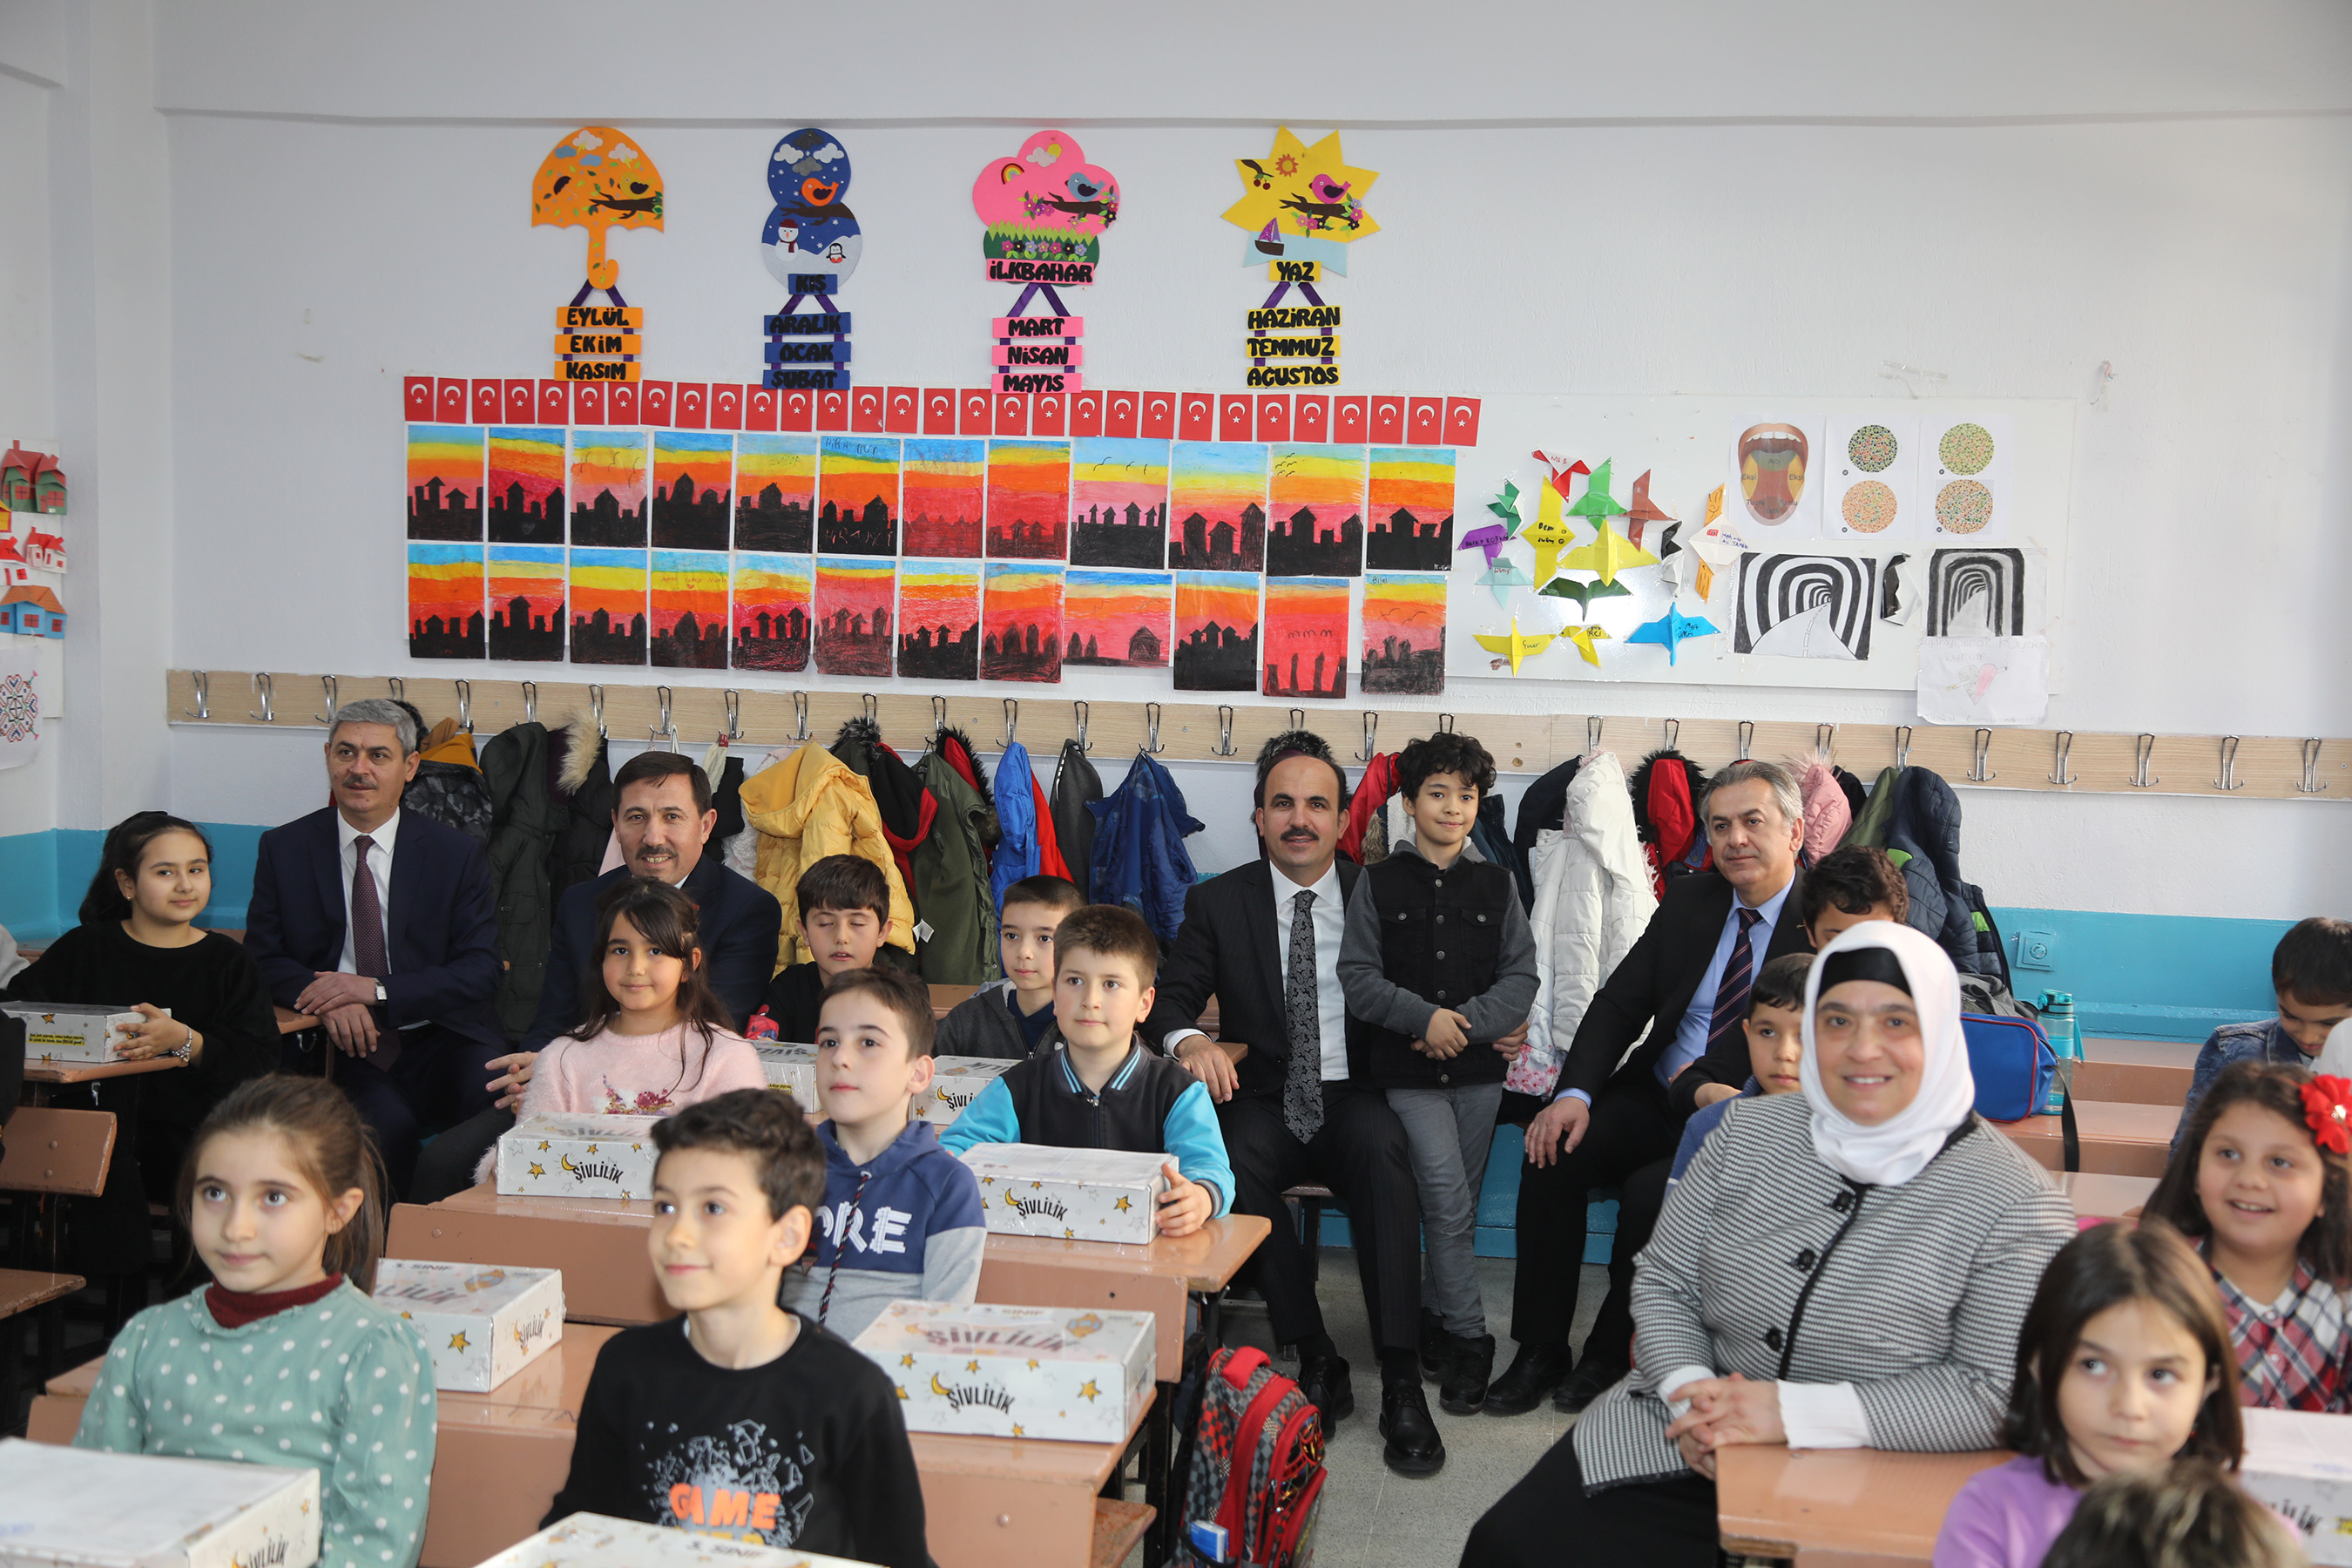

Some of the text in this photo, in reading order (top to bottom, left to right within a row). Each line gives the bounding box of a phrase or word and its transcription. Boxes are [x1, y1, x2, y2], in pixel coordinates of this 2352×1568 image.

[990, 261, 1092, 282] İLKBAHAR
[1277, 261, 1315, 281] YAZ
[795, 275, 827, 294] KIŞ
[567, 308, 630, 327] EYLÜL
[770, 314, 841, 335] ARALIK
[1247, 308, 1341, 329] HAZİRAN
[1008, 319, 1064, 337] MART
[570, 335, 622, 354] EKİM
[780, 343, 834, 362] OCAK
[1247, 337, 1335, 357] TEMMUZ
[1007, 347, 1069, 365] NİSAN
[566, 362, 626, 381] KASIM
[772, 370, 837, 389] ŞUBAT
[1247, 366, 1339, 387] AĞUSTOS
[1004, 375, 1064, 393] MAYIS
[572, 1161, 625, 1184] ŞİVLİLİK
[1017, 1196, 1068, 1221] ŞİVLİLİK
[947, 1383, 1016, 1415] ŞİVLİLİK
[670, 1483, 781, 1531] GAME
